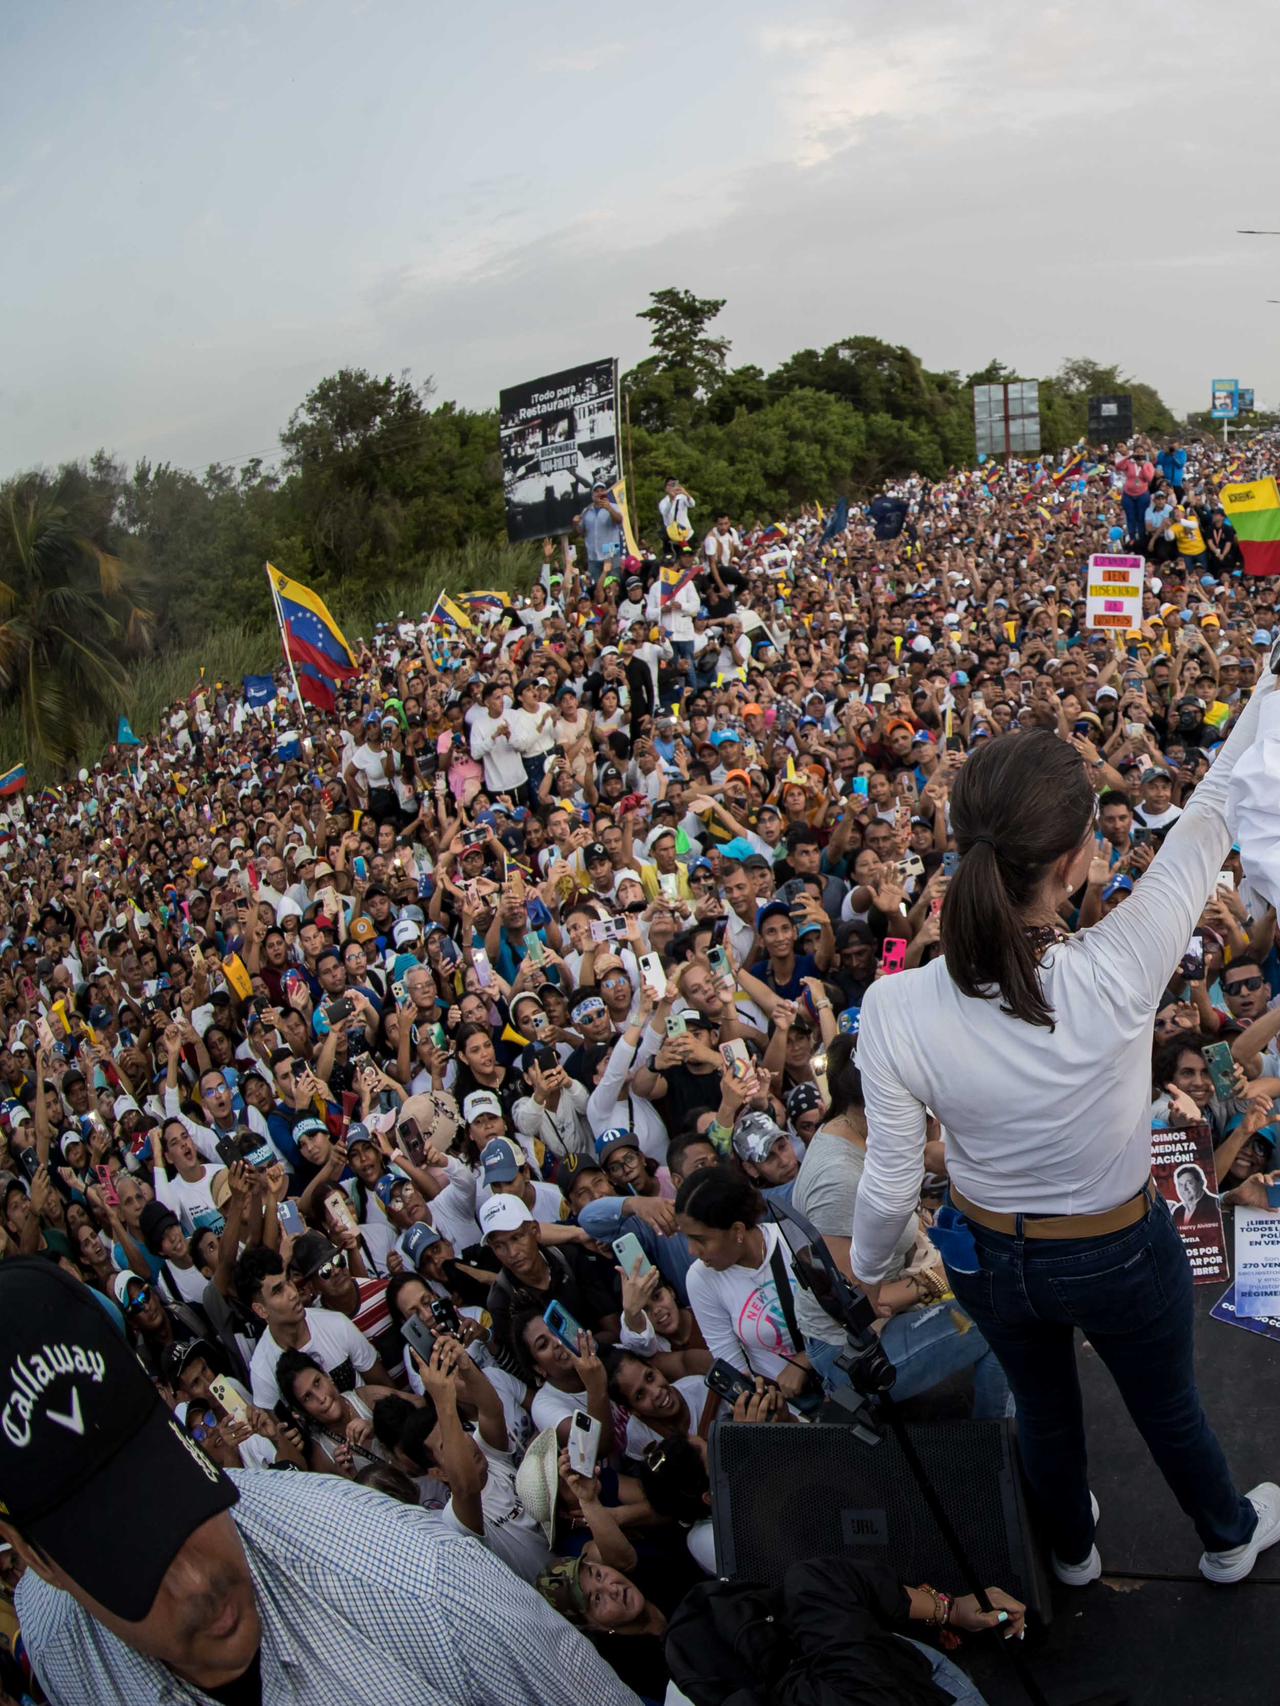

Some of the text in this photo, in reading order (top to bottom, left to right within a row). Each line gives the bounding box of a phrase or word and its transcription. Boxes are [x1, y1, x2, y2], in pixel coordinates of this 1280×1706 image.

[557, 385, 576, 398] para
[1152, 1132, 1187, 1142] GIMOS
[1151, 1142, 1197, 1154] MEDIATA
[1151, 1153, 1194, 1165] RACIÓN!
[1199, 1246, 1219, 1256] POR
[1203, 1255, 1223, 1265] POR
[1193, 1266, 1220, 1276] IBRES
[747, 1289, 769, 1321] NEW
[1, 1343, 106, 1448] Callaway
